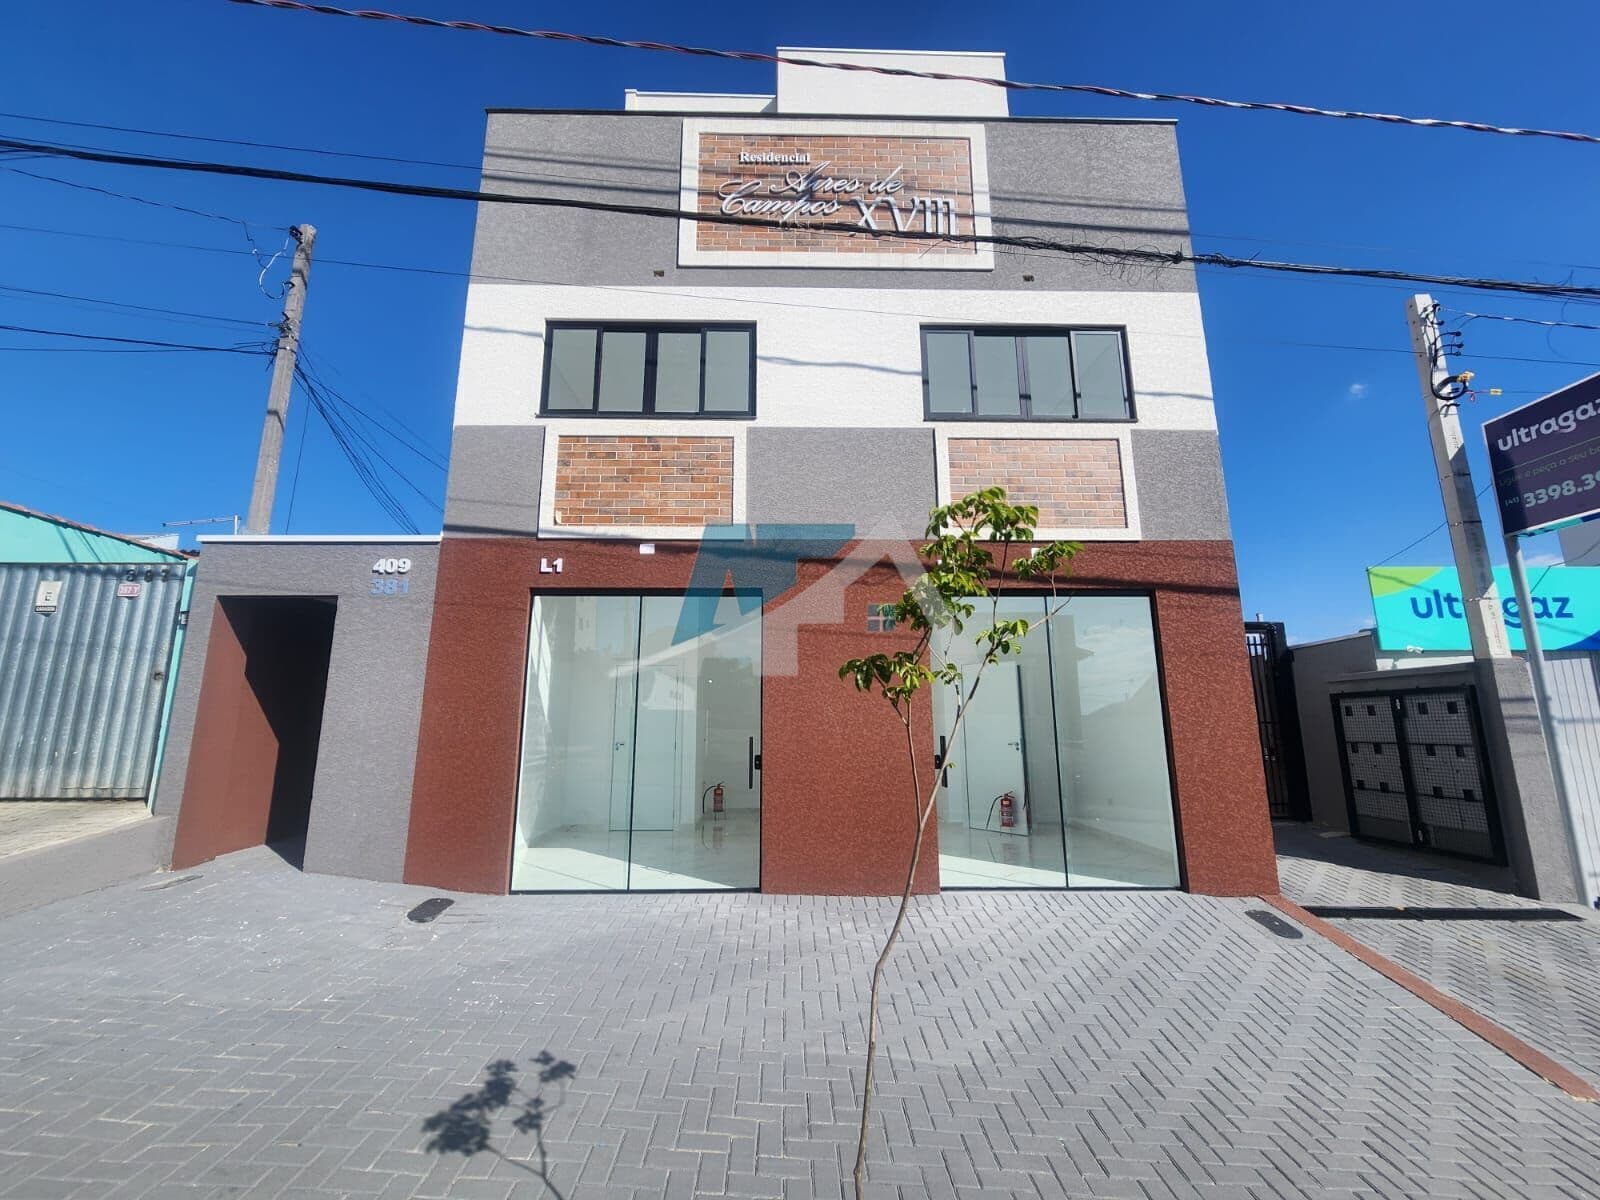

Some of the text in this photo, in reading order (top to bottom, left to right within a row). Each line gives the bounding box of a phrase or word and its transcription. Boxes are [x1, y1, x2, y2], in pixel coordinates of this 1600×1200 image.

[739, 149, 811, 165] Residencial
[869, 165, 904, 194] de
[719, 180, 841, 222] Campos
[372, 558, 412, 575] 409
[539, 557, 564, 574] L1
[1410, 589, 1574, 629] ultgaz
